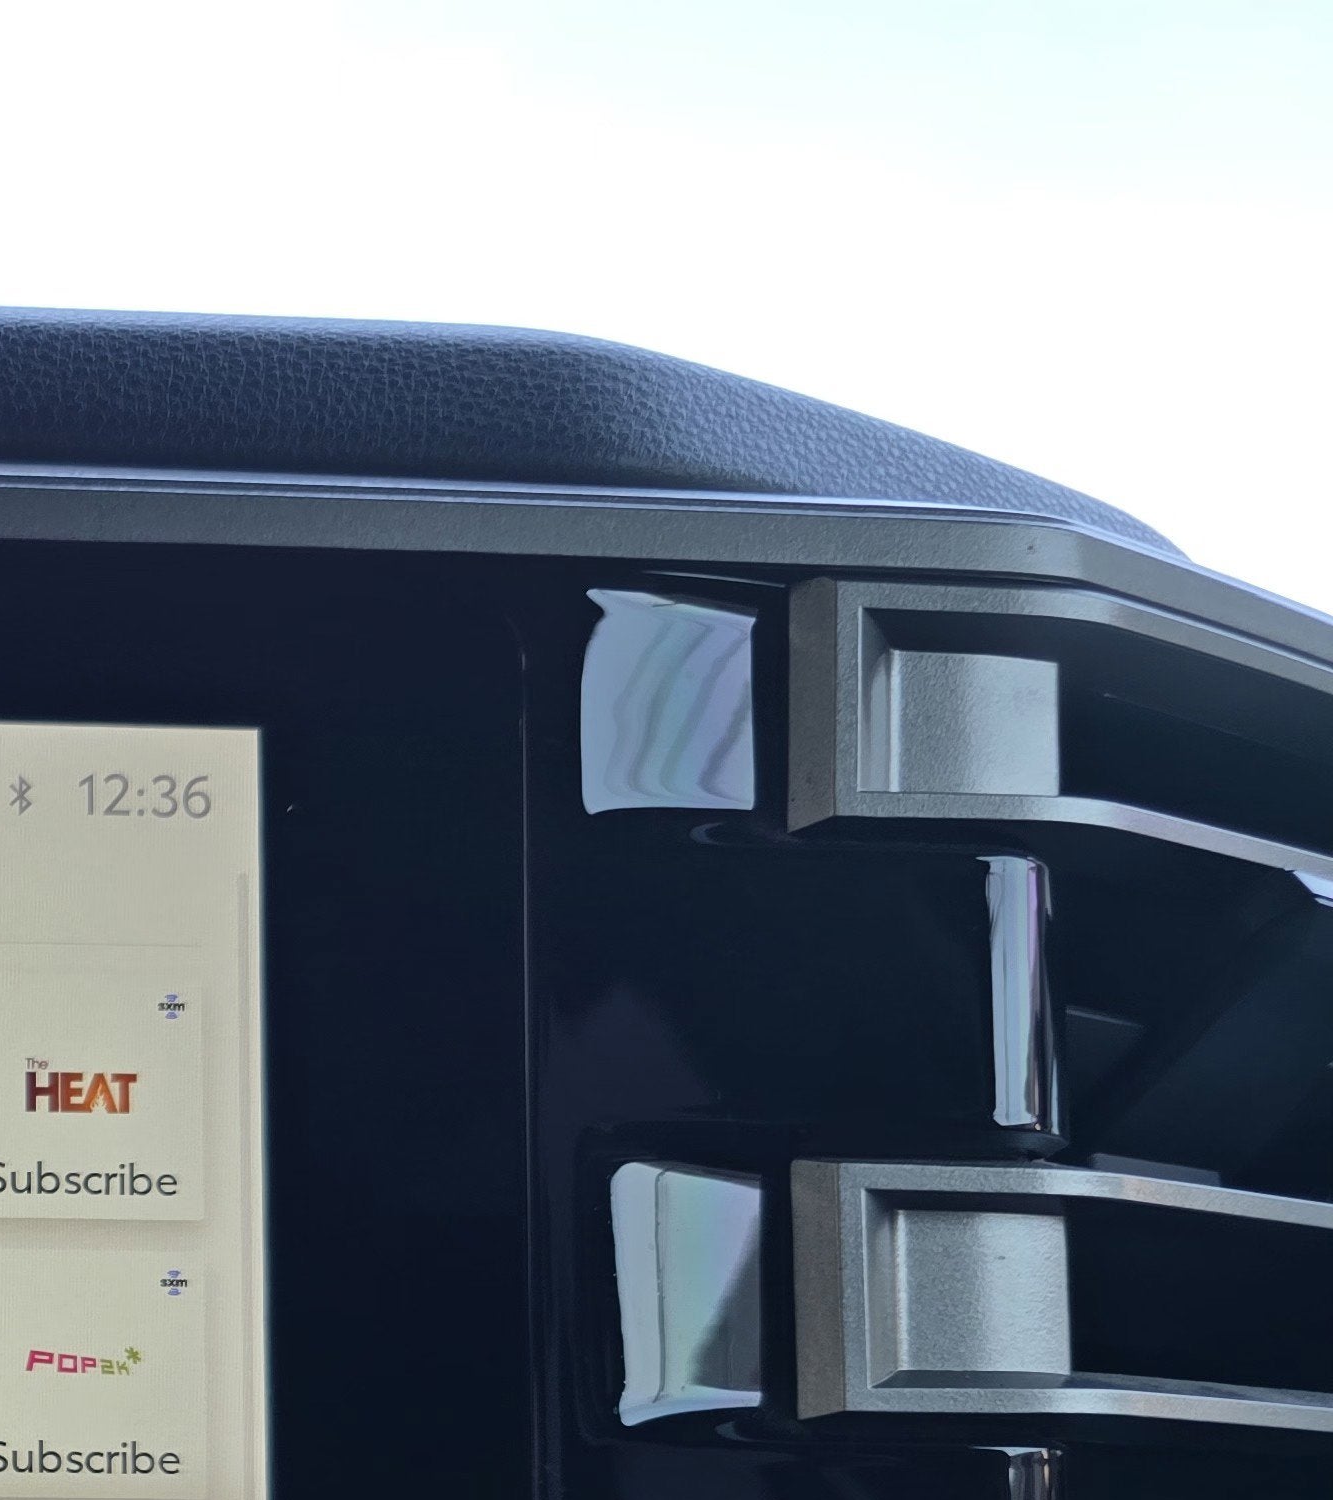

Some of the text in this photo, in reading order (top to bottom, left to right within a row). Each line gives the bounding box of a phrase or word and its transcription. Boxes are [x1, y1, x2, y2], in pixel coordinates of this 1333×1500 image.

[78, 773, 212, 819] 12:36
[25, 1058, 49, 1070] The
[25, 1071, 138, 1114] HEAT
